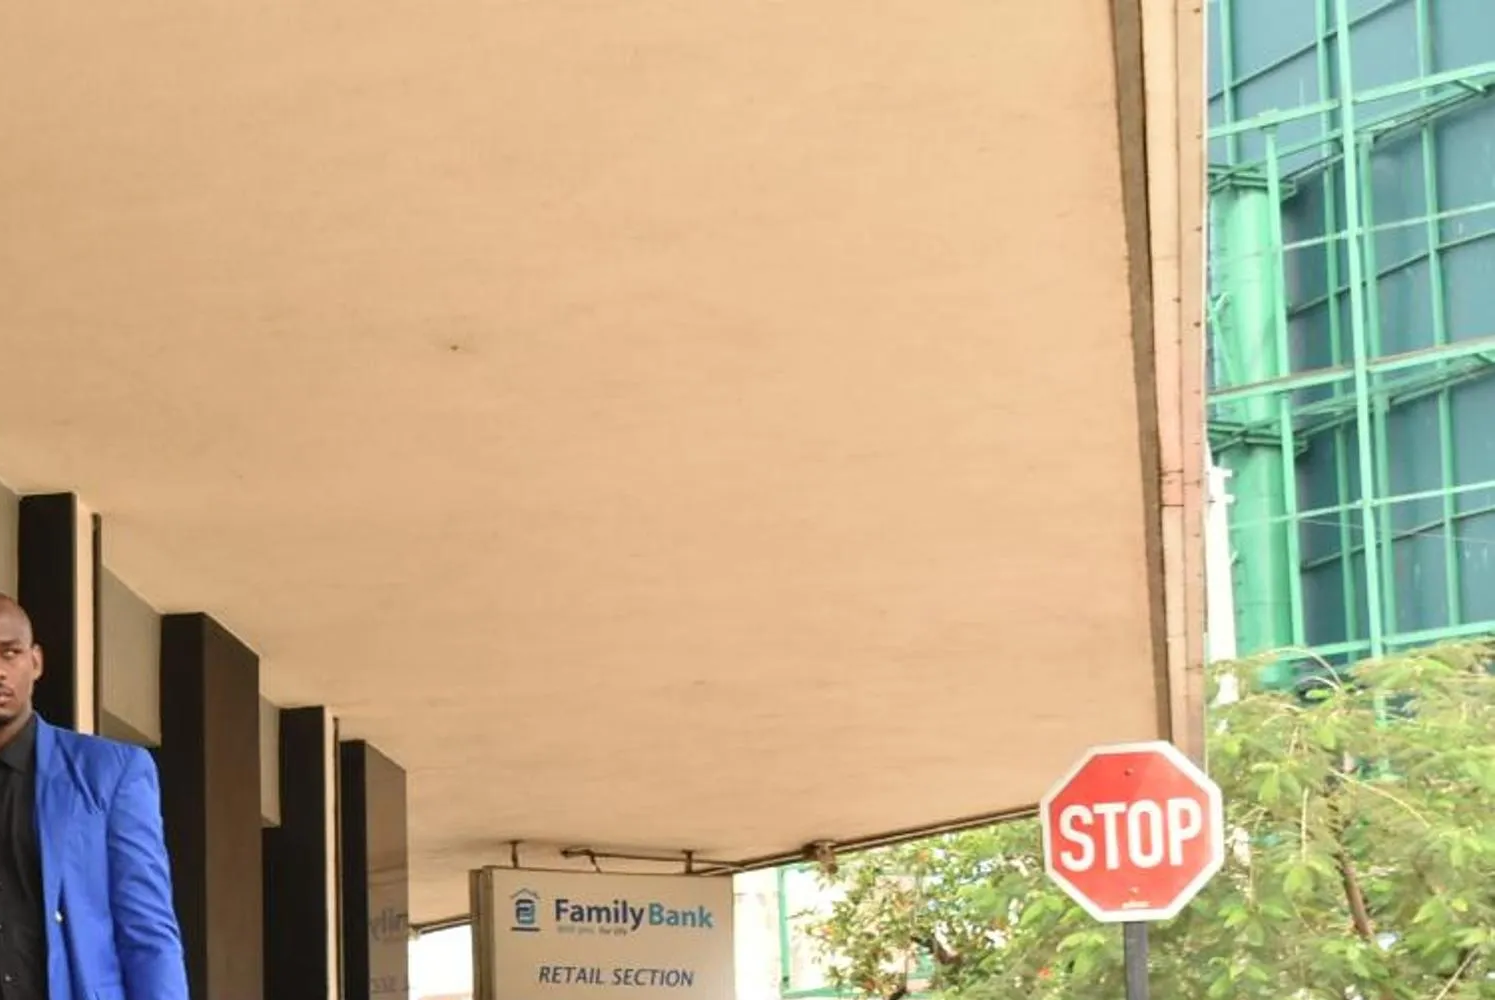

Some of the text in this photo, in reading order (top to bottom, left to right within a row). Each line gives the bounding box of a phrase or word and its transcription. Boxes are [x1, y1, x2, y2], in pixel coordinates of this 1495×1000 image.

[1059, 797, 1202, 872] STOP
[554, 899, 714, 931] Family Bank
[538, 966, 695, 987] RETAIL SECTION
